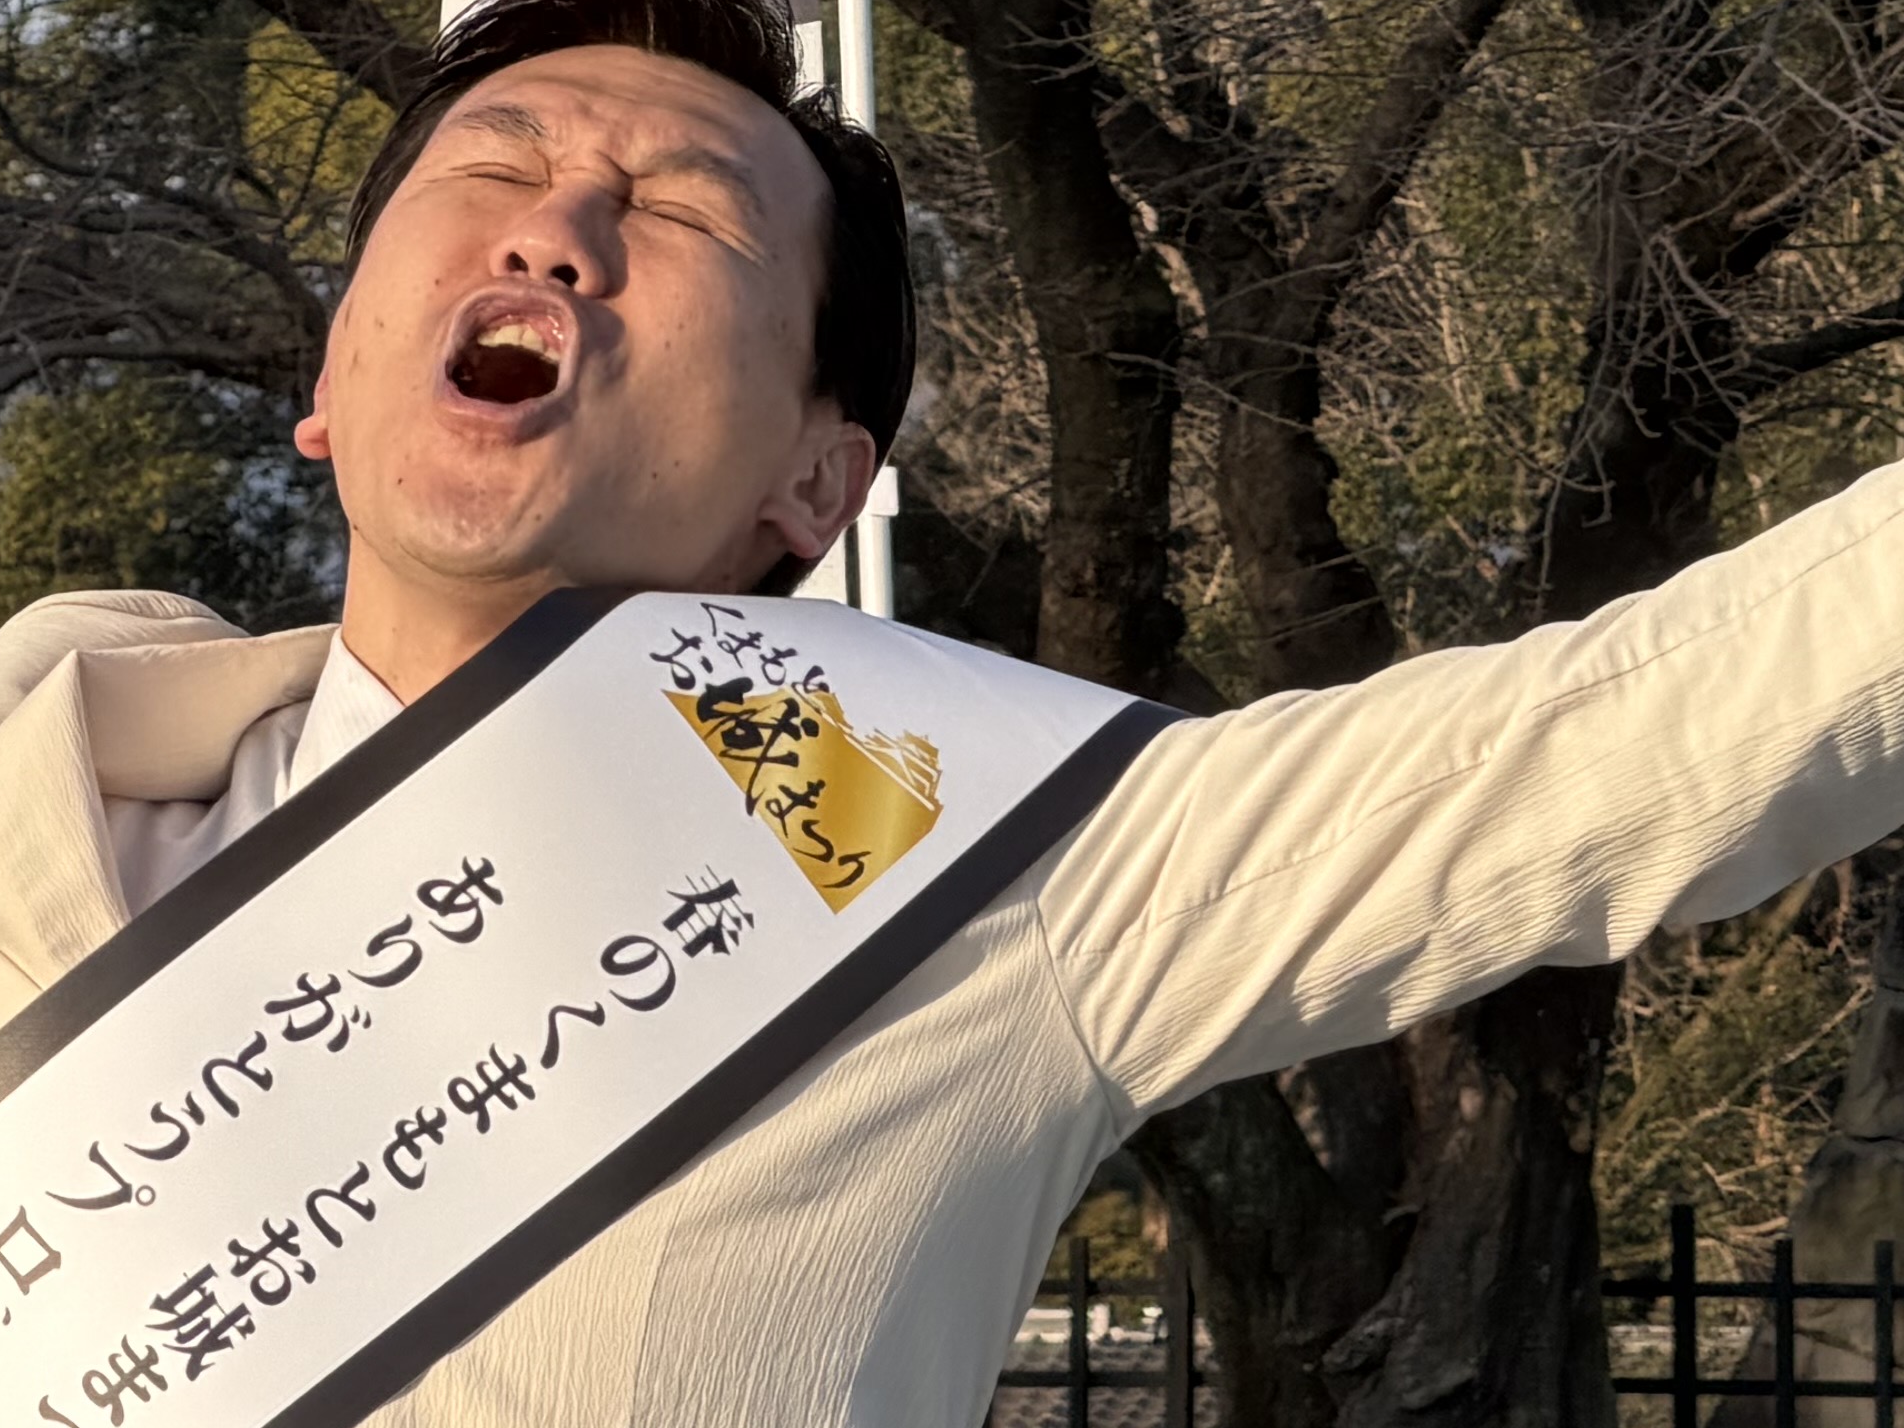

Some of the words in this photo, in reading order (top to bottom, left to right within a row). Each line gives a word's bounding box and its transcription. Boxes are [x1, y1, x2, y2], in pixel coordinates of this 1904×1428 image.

[699, 601, 831, 695] くまもと
[649, 627, 872, 889] お城まつり
